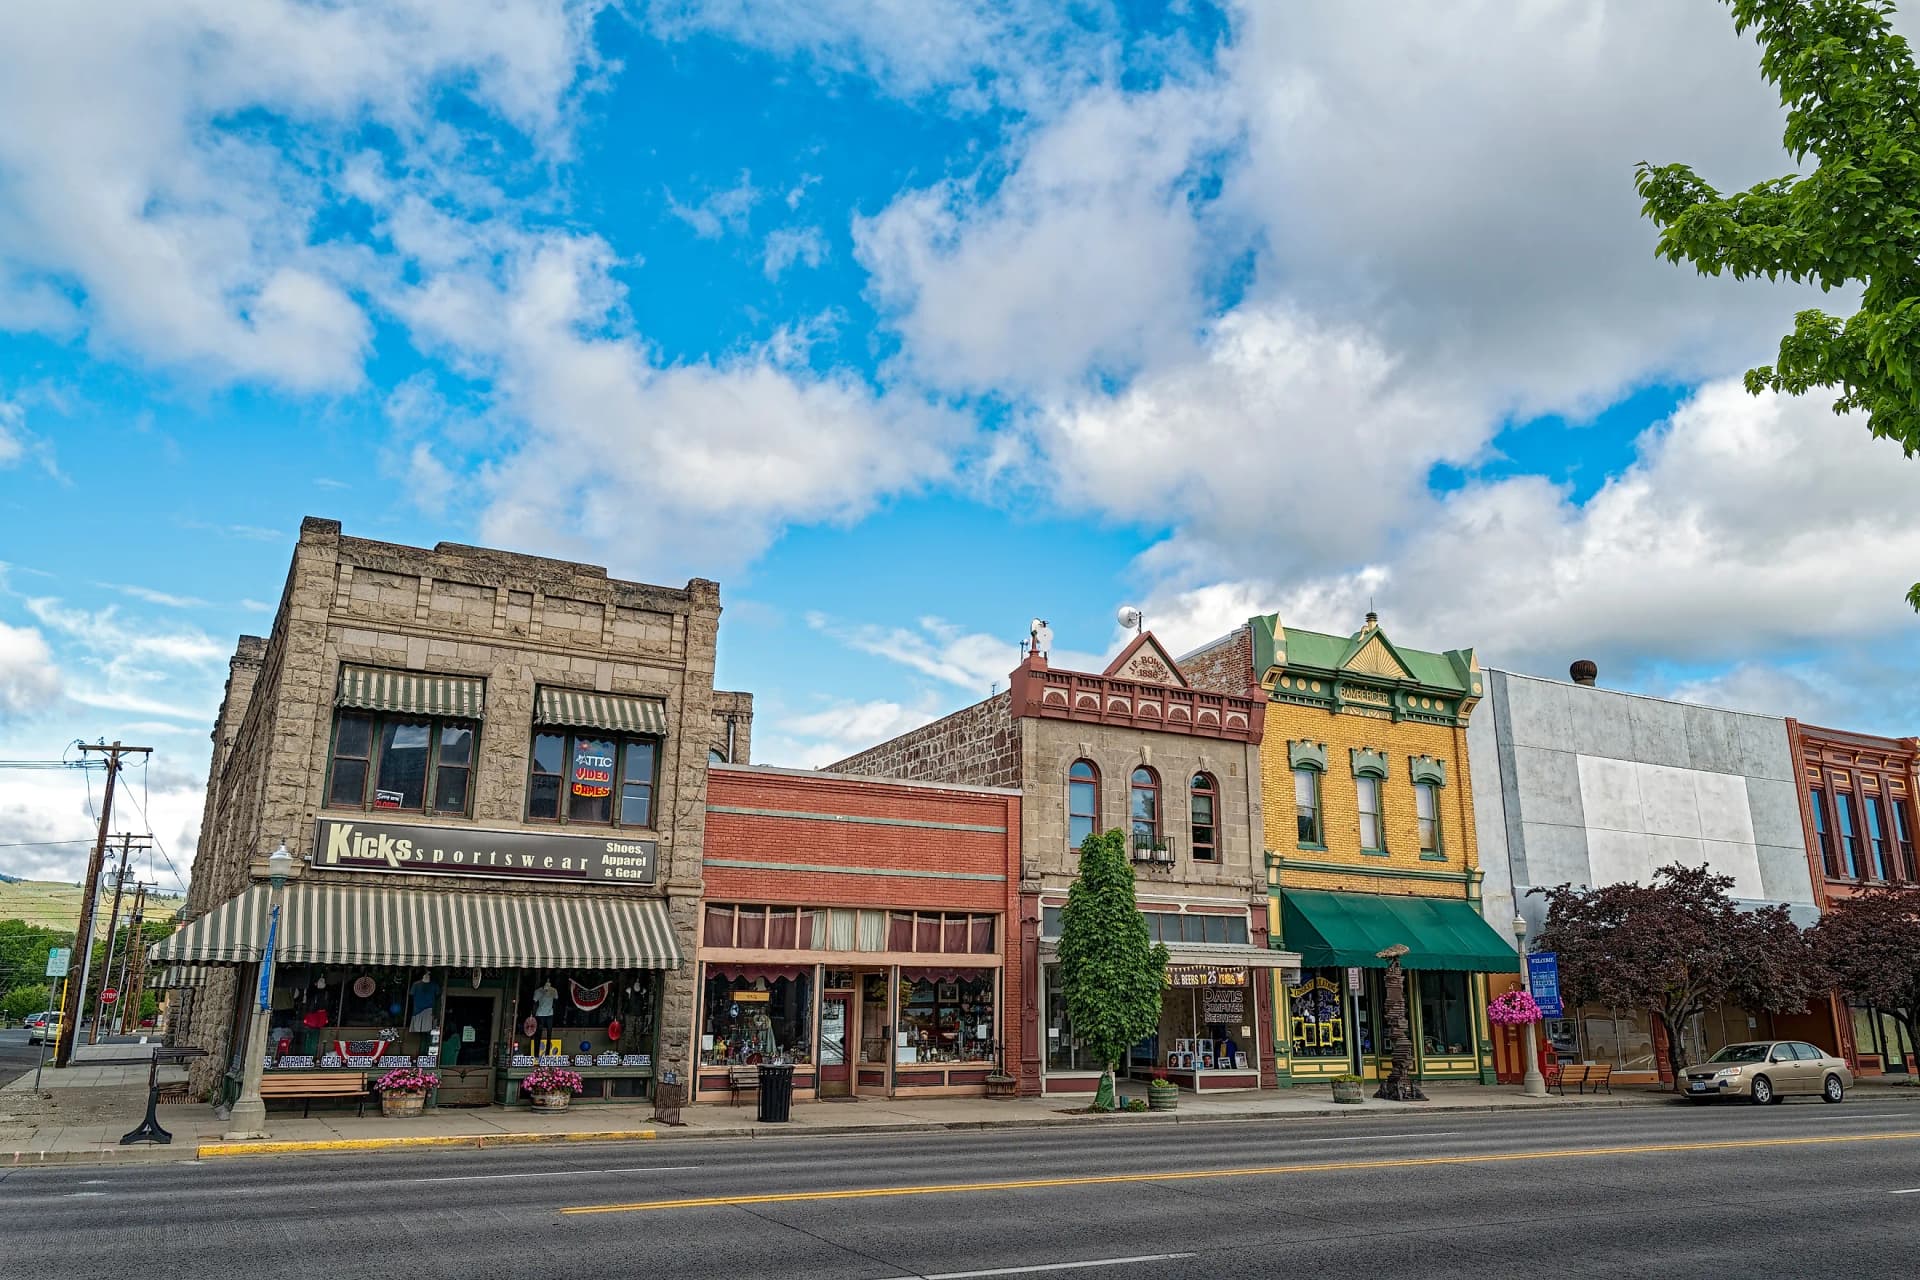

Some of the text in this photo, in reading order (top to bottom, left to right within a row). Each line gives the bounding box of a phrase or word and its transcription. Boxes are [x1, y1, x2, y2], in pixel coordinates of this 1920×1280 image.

[1340, 686, 1389, 705] BAMBERGER
[576, 753, 612, 767] ATTIC
[576, 767, 610, 782] VIDEO
[573, 783, 611, 797] GAMES
[326, 823, 588, 871] Kicks sportswear
[606, 841, 644, 855] Shoes,
[601, 854, 647, 868] Apparel
[604, 867, 643, 879] & Gear
[1181, 974, 1199, 985] BEERS
[1200, 974, 1207, 984] TO
[1208, 971, 1217, 984] 25
[1218, 973, 1236, 985] YEARS
[101, 991, 117, 999] STOP
[1203, 988, 1243, 1003] DAVIS
[278, 1056, 315, 1067] APPAREL
[321, 1056, 342, 1067] GEAR
[347, 1056, 372, 1067] SHOES
[378, 1056, 412, 1067] APPAREL
[512, 1056, 535, 1066] SHOES
